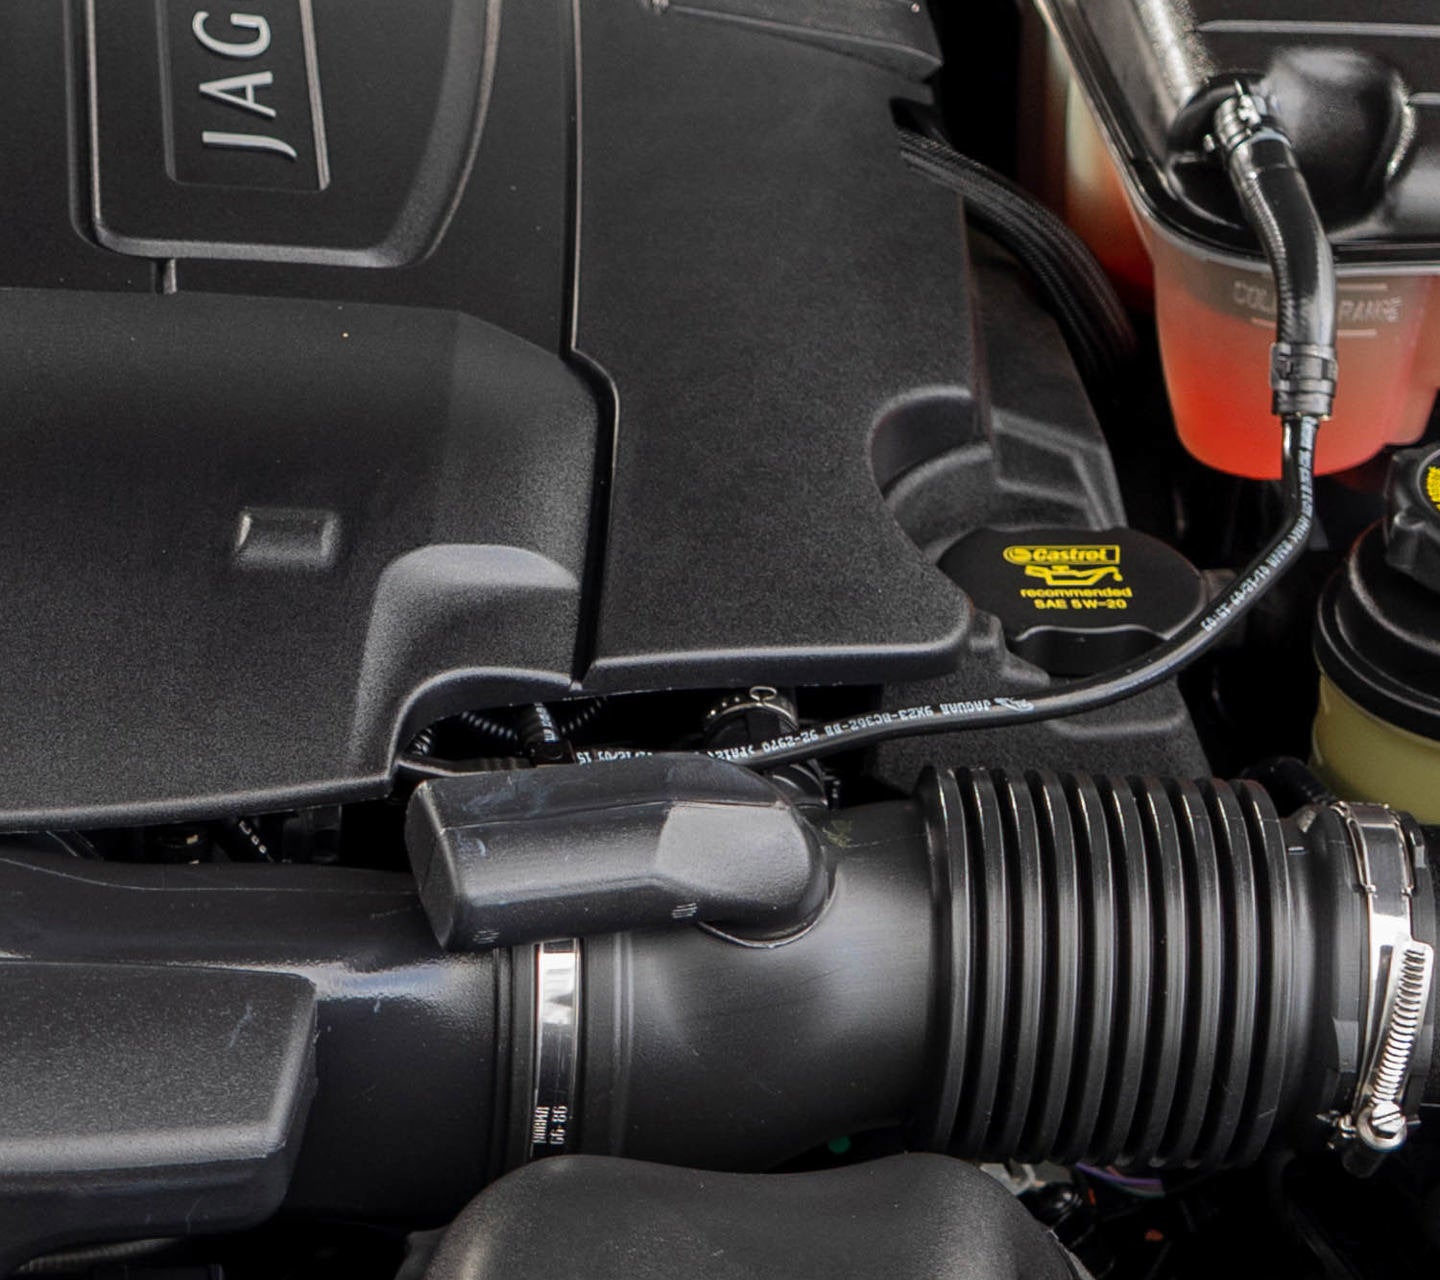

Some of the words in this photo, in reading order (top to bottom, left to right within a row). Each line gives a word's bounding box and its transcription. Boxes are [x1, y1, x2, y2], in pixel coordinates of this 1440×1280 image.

[1032, 548, 1107, 562] Castrol
[1020, 587, 1133, 598] recommended
[1034, 599, 1068, 609] SAE
[1071, 599, 1128, 609] 5W-20
[939, 700, 991, 718] JAGUAR
